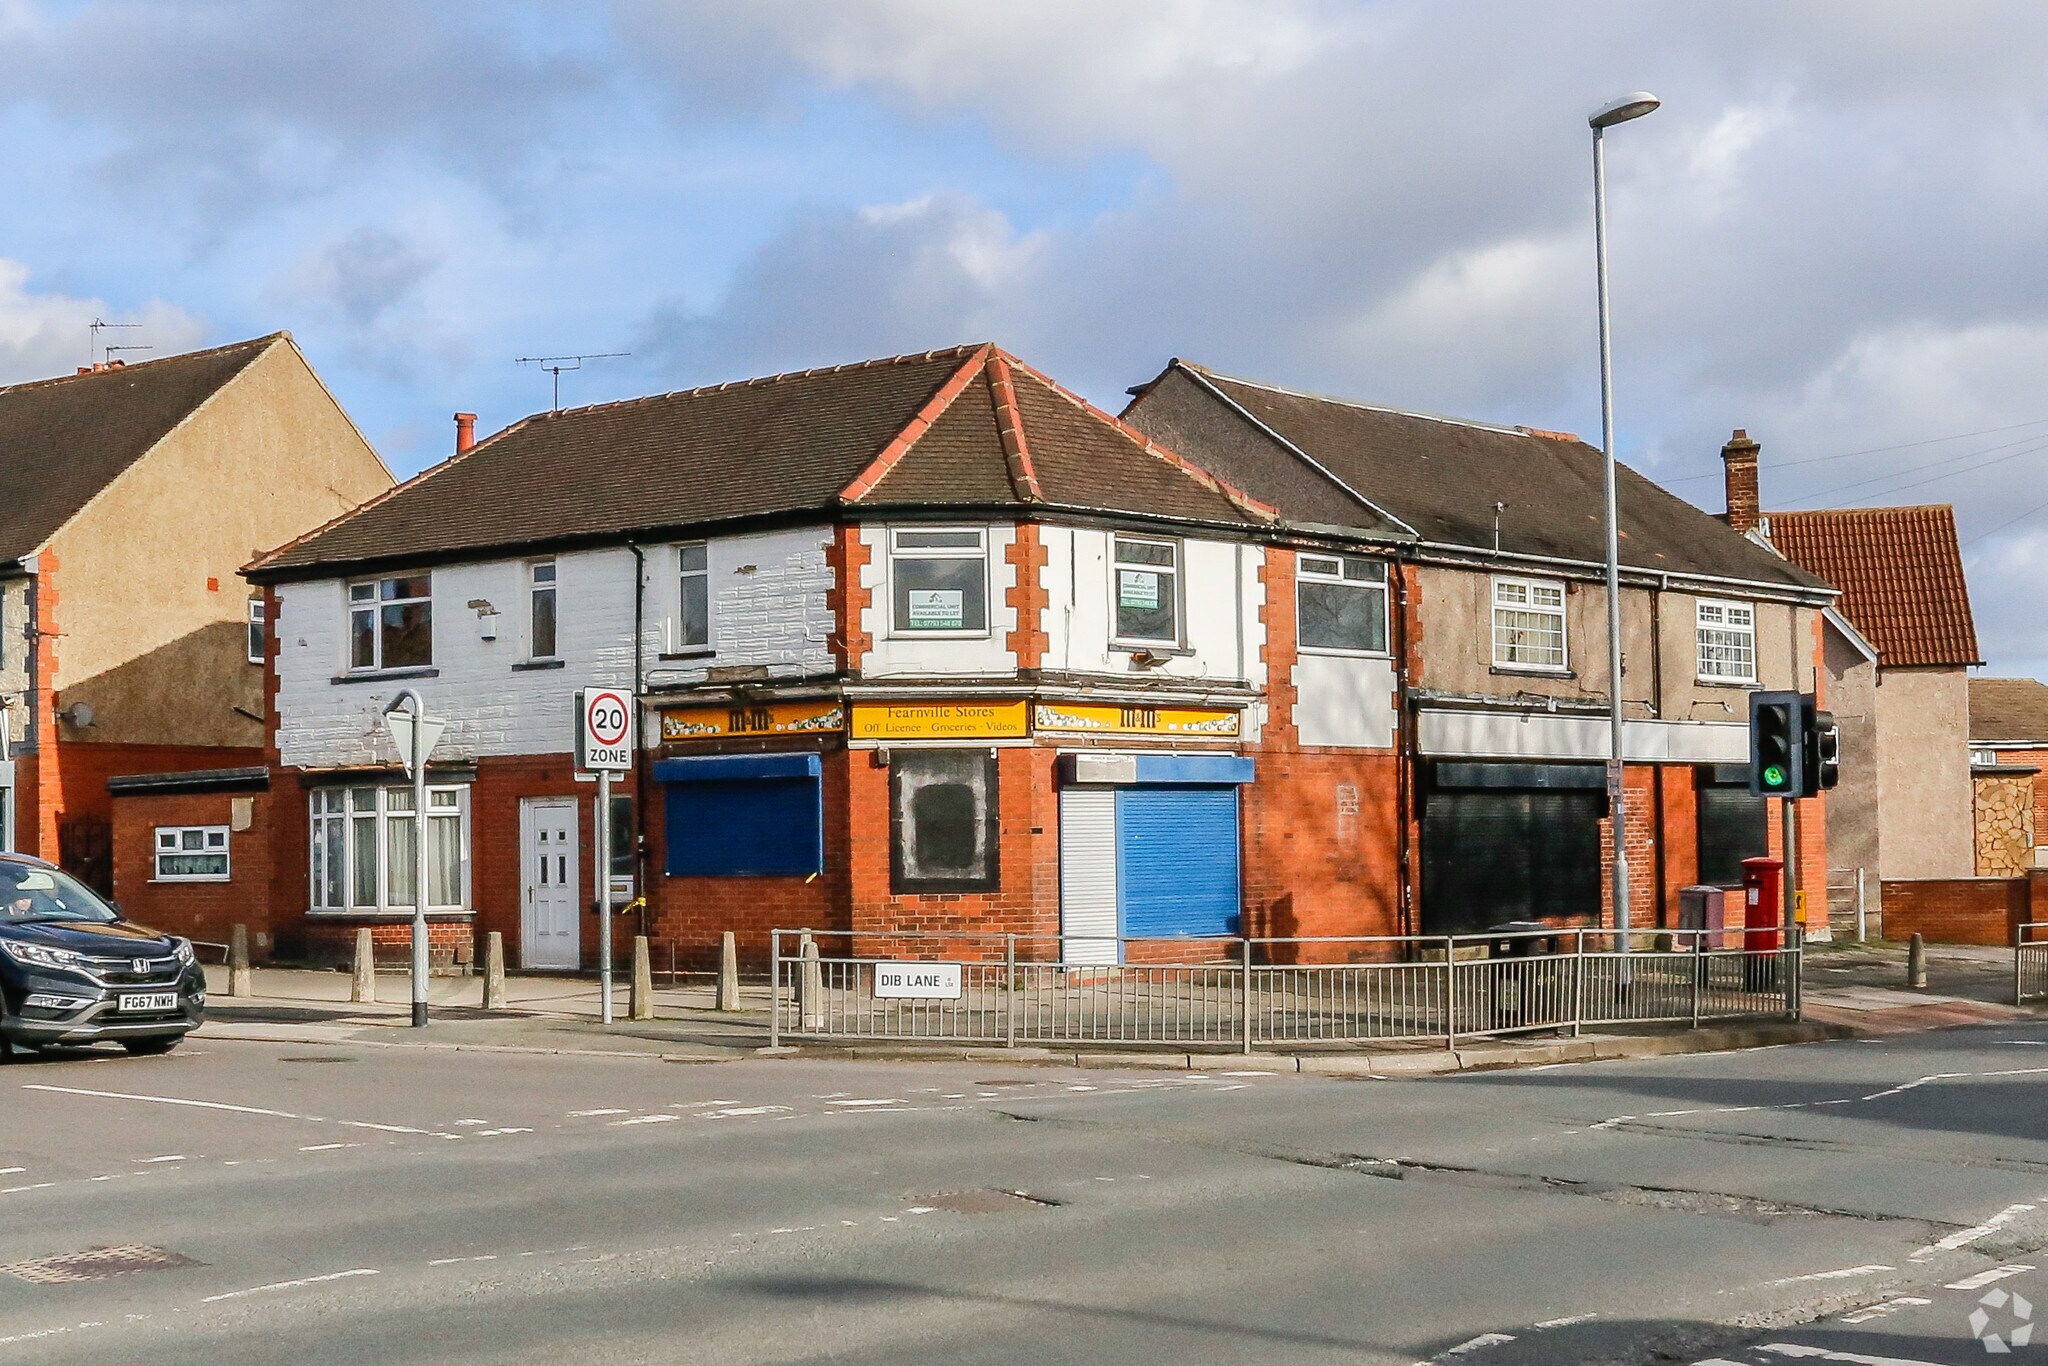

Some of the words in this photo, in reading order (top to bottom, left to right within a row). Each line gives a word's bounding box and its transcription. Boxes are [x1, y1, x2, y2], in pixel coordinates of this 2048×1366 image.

[888, 706, 950, 718] Fearnville
[956, 706, 995, 718] Stores
[595, 708, 623, 730] 20
[864, 723, 880, 733] Off
[886, 723, 921, 732] Licence
[931, 722, 977, 732] Groceries
[986, 722, 1018, 731] Videos
[590, 748, 627, 763] ZONE
[881, 974, 902, 987] DIB
[907, 975, 940, 987] LANE
[124, 996, 153, 1009] FG67
[154, 995, 174, 1007] NWH
